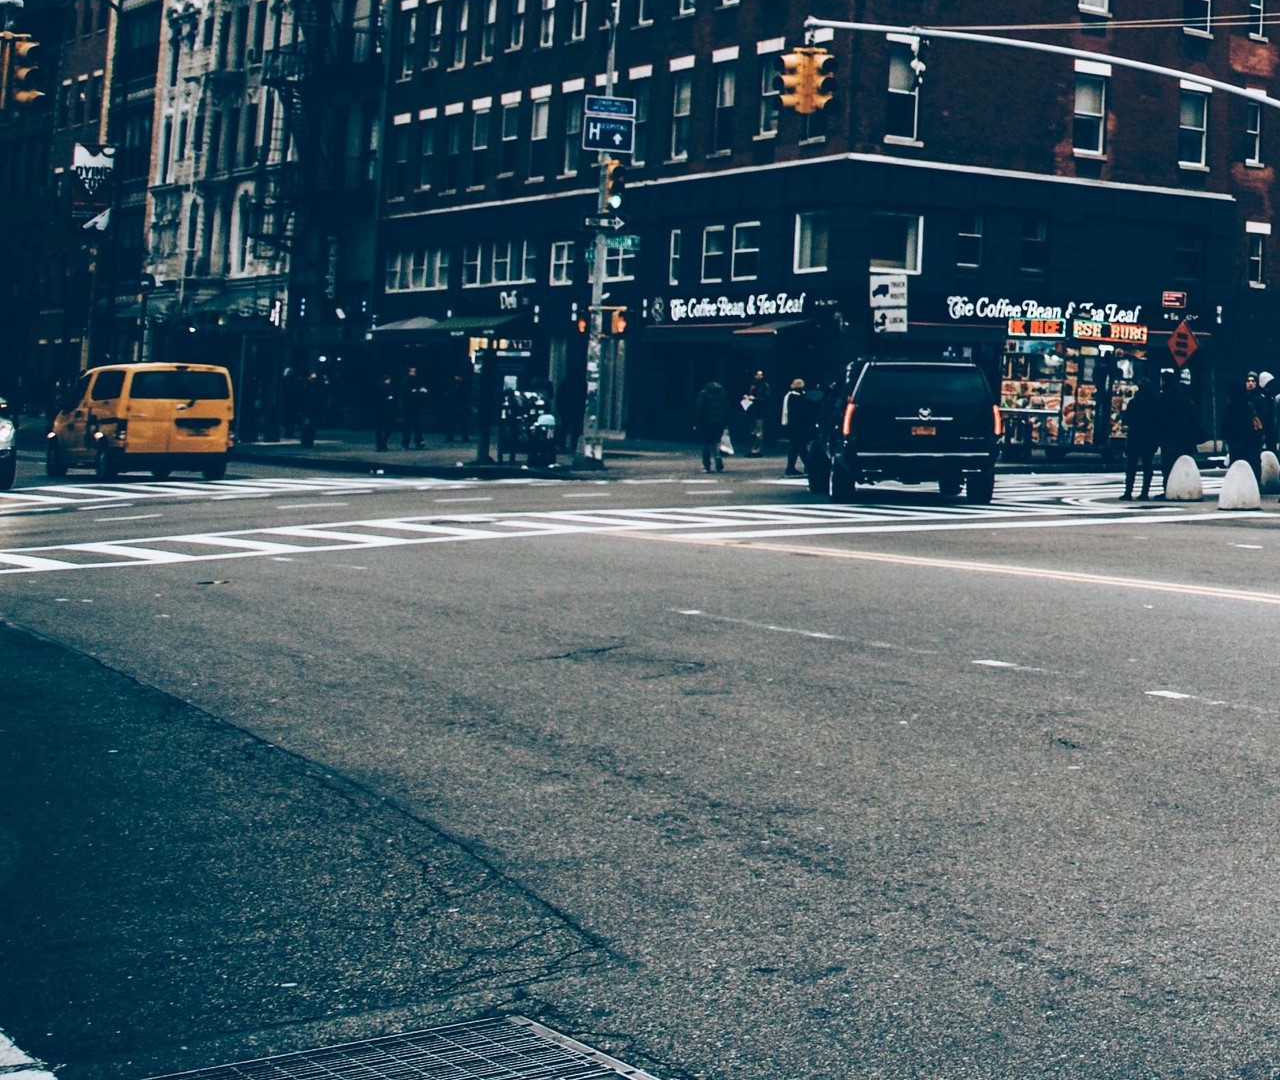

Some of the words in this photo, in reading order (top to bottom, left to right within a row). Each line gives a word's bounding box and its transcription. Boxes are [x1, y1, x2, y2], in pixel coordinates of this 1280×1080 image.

[670, 299, 687, 321] The
[688, 297, 717, 318] Coffee
[717, 296, 746, 318] Bean
[747, 294, 757, 315] &
[757, 293, 776, 315] Tea
[777, 292, 806, 314] Leaf
[946, 295, 974, 319] The
[975, 297, 1022, 318] Coffee
[1022, 299, 1062, 319] Bean
[1105, 304, 1142, 323] Leaf
